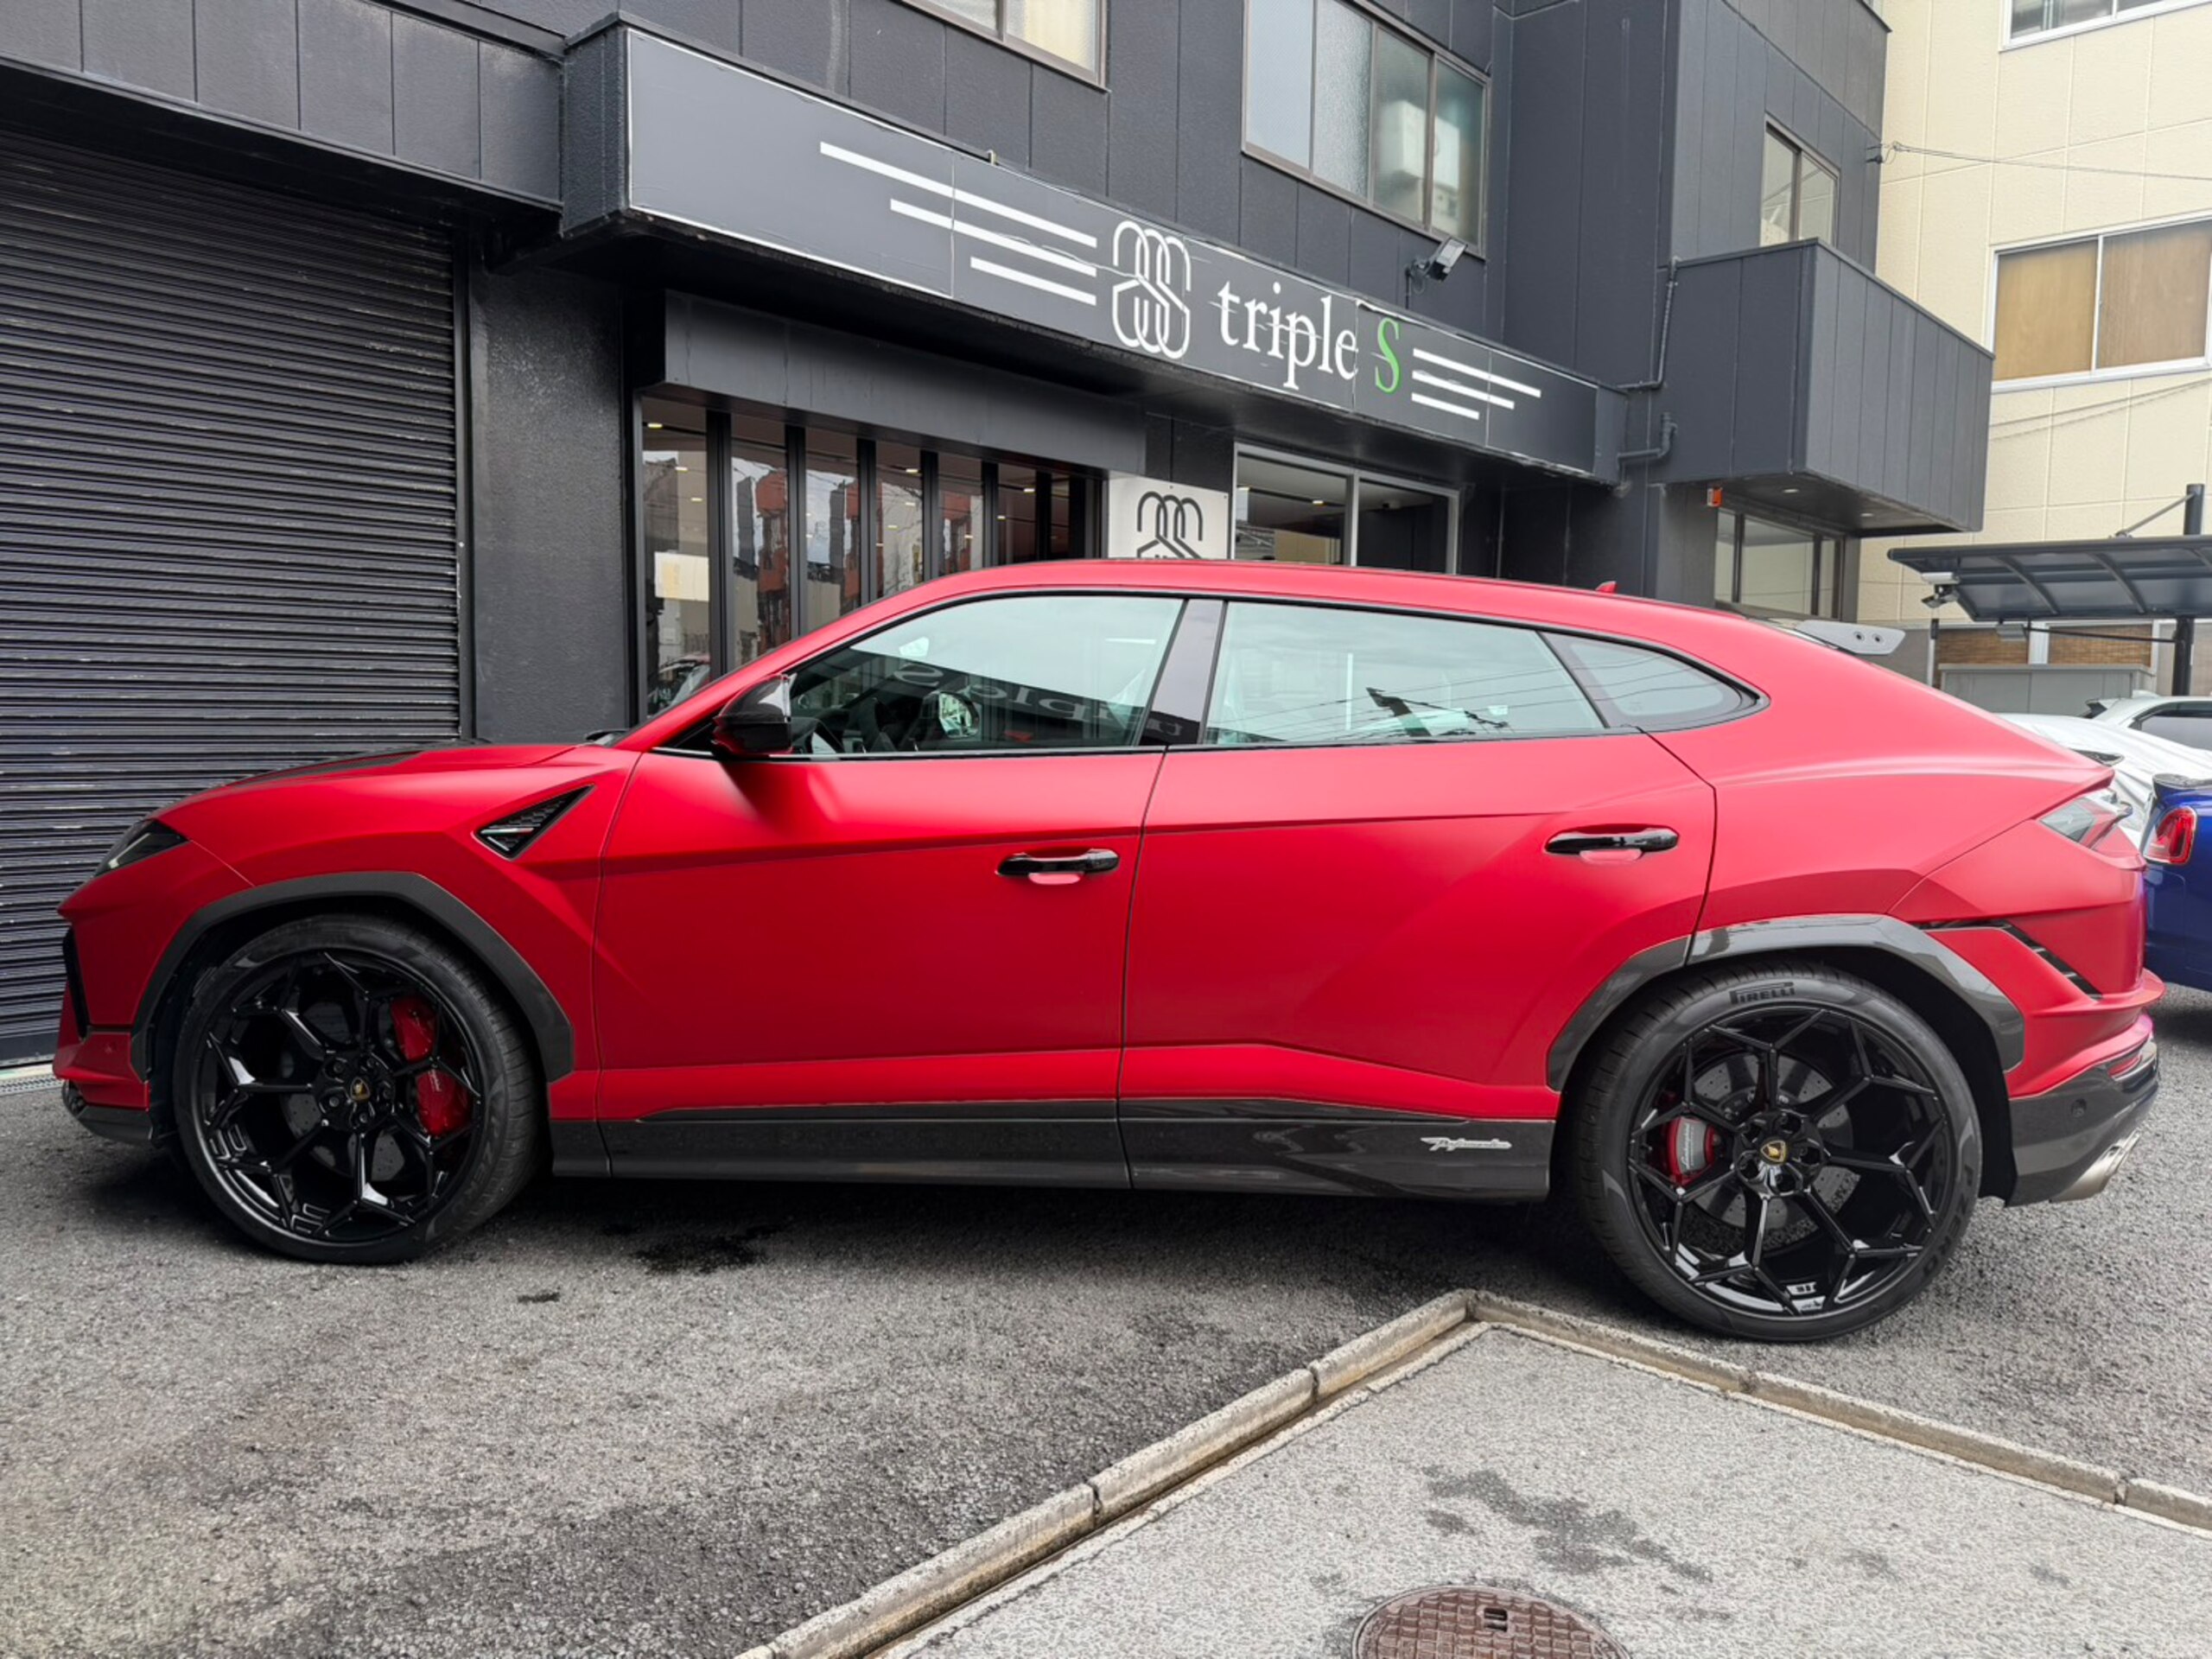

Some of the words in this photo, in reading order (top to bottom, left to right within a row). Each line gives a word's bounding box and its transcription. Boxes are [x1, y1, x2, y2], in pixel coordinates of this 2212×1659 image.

[1217, 281, 1359, 390] triple
[1375, 316, 1400, 392] S
[1729, 982, 1796, 1004] PIRELLI
